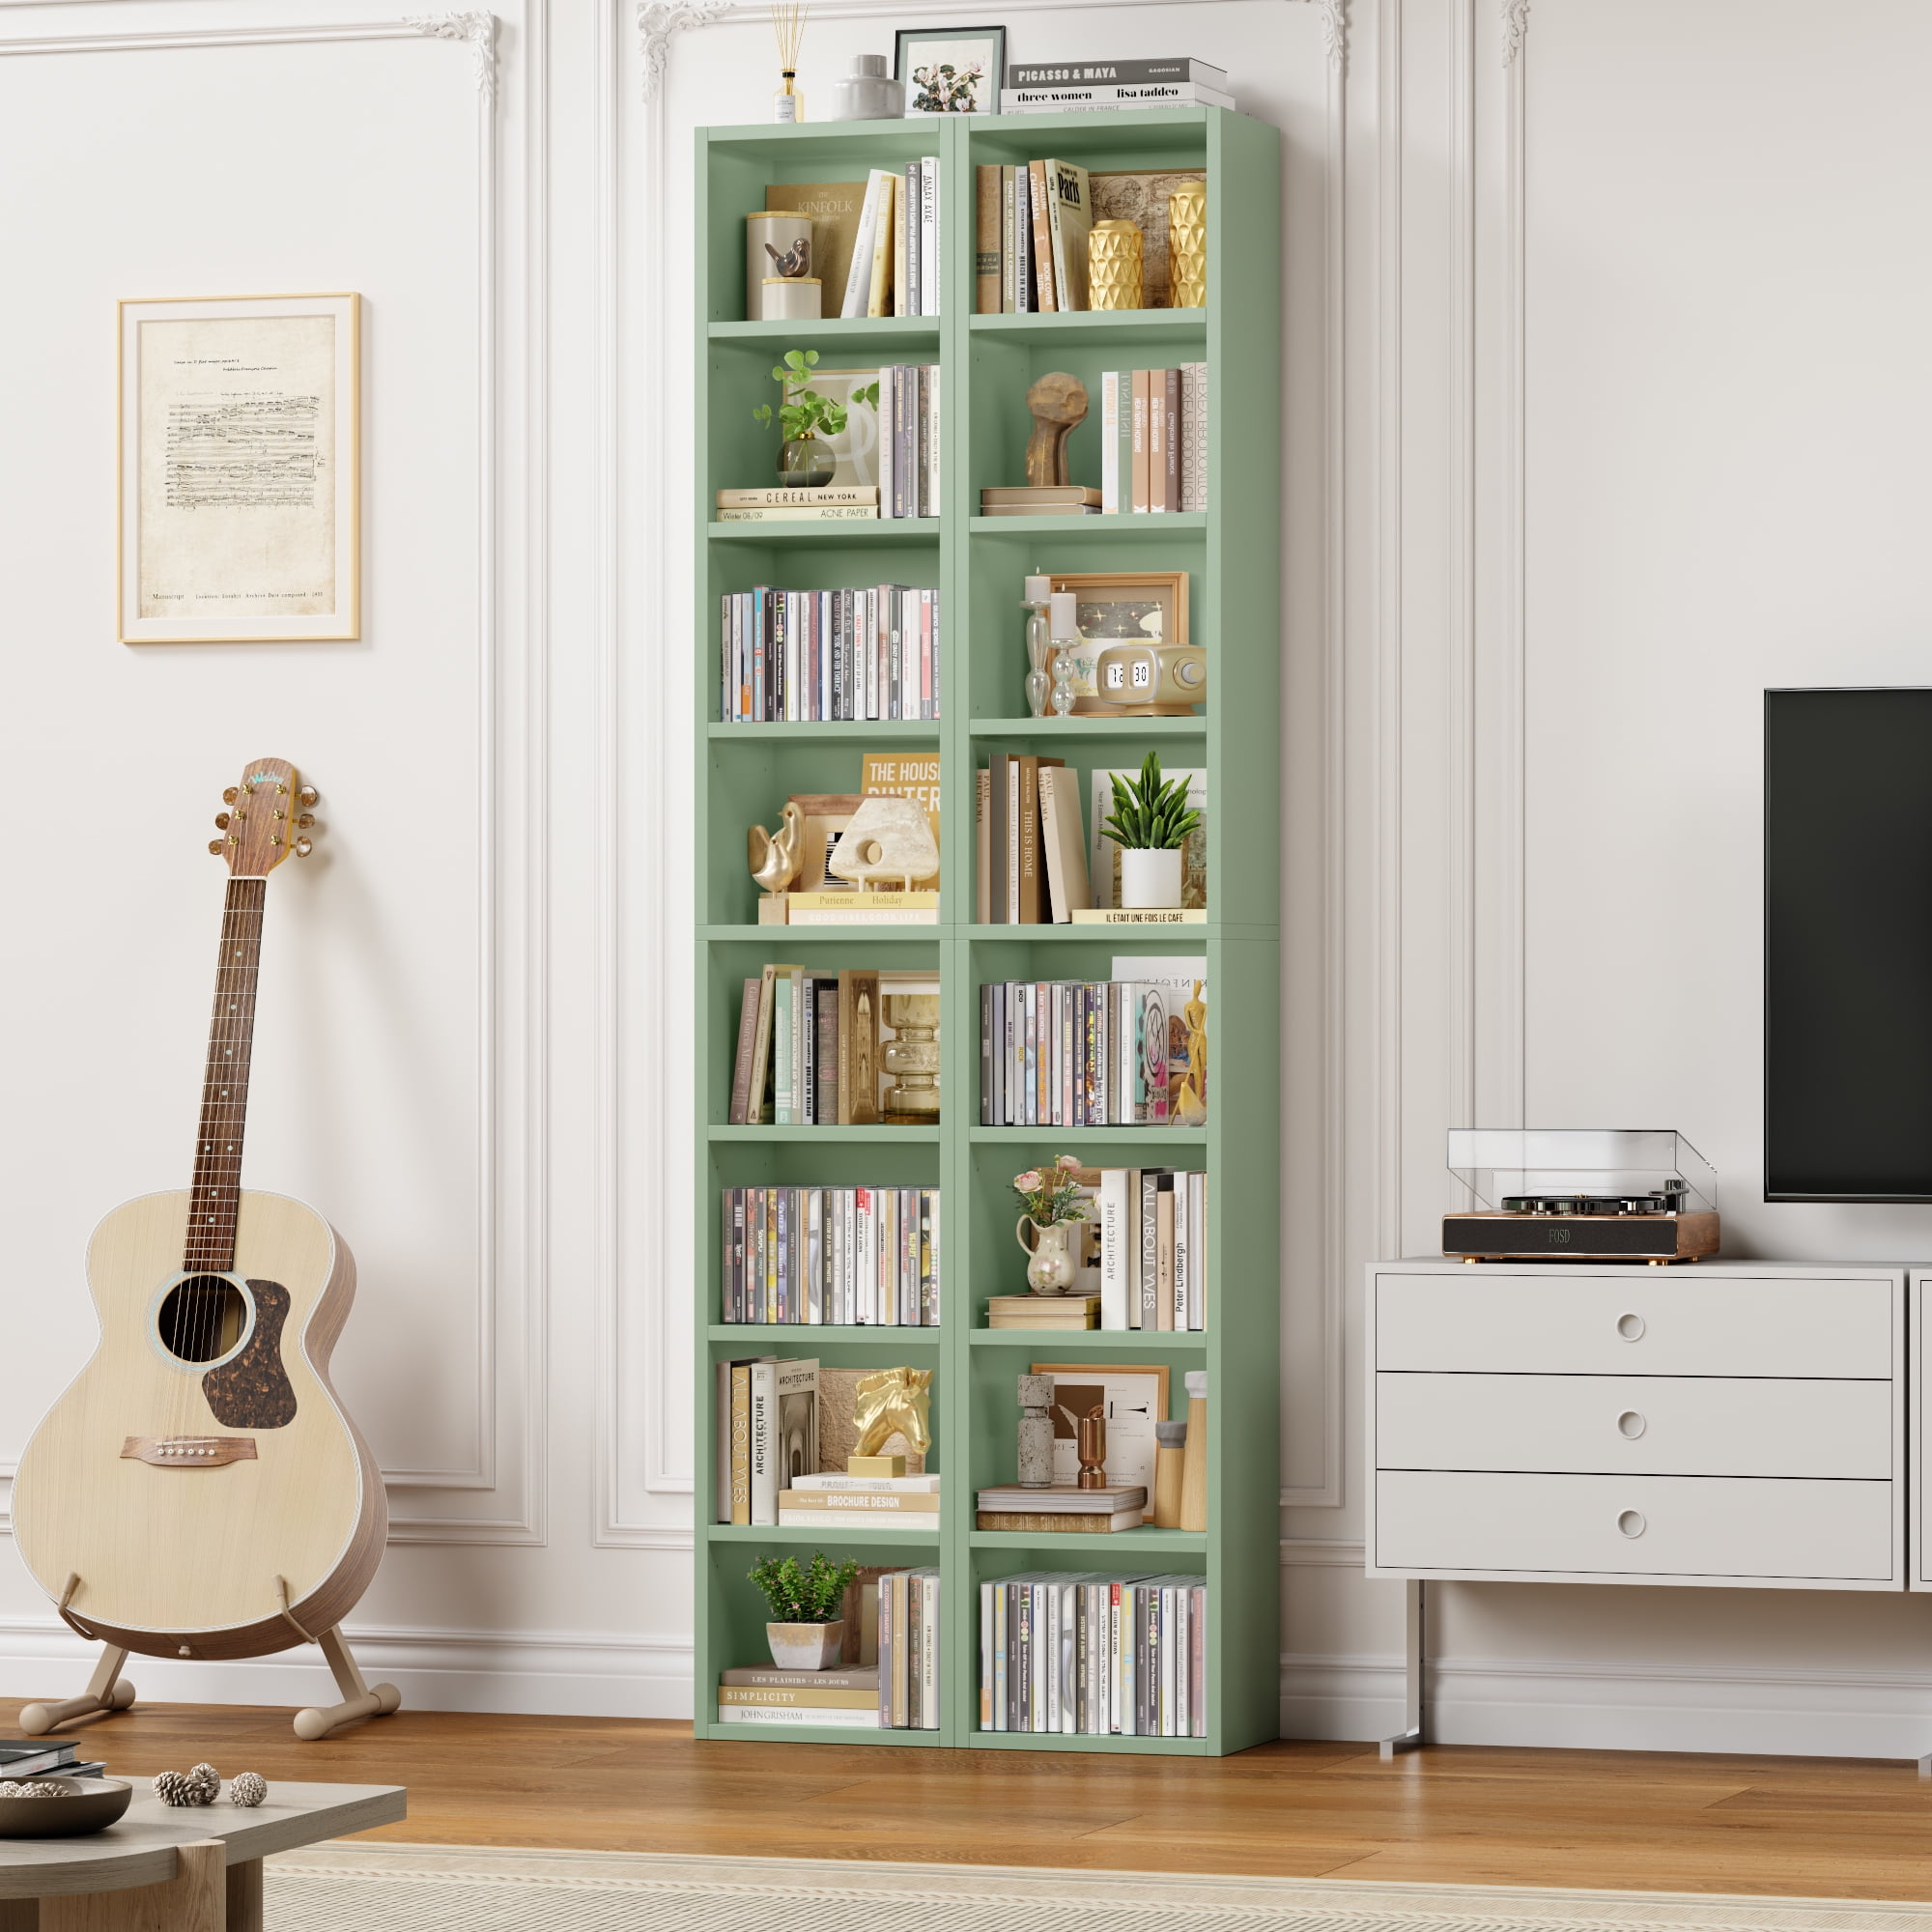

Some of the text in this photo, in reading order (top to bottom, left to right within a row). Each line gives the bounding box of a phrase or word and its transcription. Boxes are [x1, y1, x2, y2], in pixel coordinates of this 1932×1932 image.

[1018, 67, 1117, 81] PICASSO & MAYA
[1017, 91, 1092, 102] three women
[1117, 87, 1179, 99] lisa taddeo
[1058, 173, 1080, 204] Paris
[798, 201, 852, 213] KINFOLK
[766, 493, 812, 503] CEREAL
[820, 508, 868, 518] ACNE PAPER
[1136, 667, 1146, 681] 30
[869, 762, 940, 781] THE HOUS
[1038, 774, 1048, 821] SIETSEMA
[1024, 810, 1033, 878] THIS IS HOME
[873, 895, 903, 906] Holiday
[1106, 912, 1183, 923] IL ÉTAIT UNE FOIS LE CAFÉ
[747, 986, 756, 1016] Gabriel
[1549, 1229, 1570, 1243] FOSD
[1144, 1182, 1155, 1309] ALL ABOUT YVES
[1176, 1242, 1185, 1287] Lindbergh
[780, 1372, 814, 1384] ARCHITECTURE
[733, 1376, 747, 1503] ALL ABOUT YVES
[755, 1396, 764, 1475] ARCHITECTURE
[827, 1495, 899, 1508] BROCHURE DESIGN
[726, 1691, 796, 1702] SIMPLICITY
